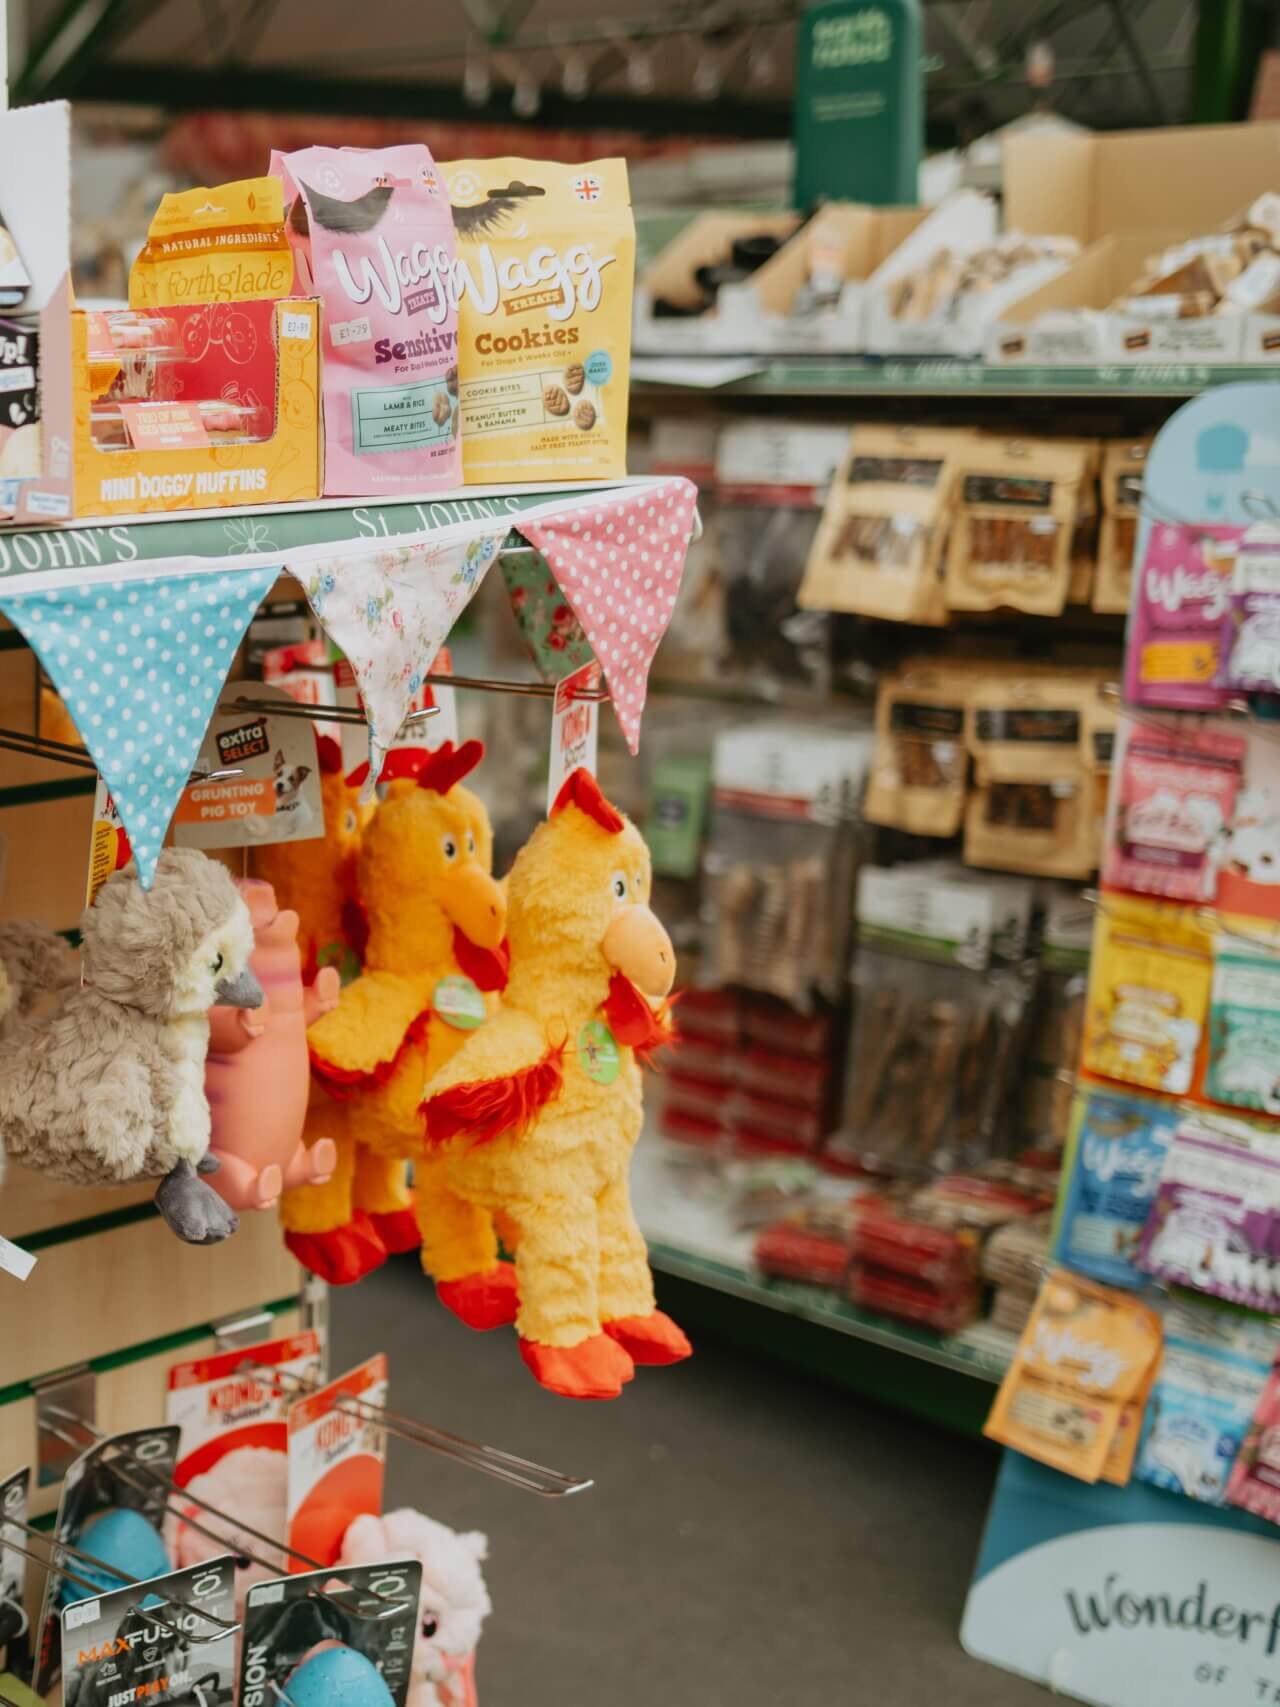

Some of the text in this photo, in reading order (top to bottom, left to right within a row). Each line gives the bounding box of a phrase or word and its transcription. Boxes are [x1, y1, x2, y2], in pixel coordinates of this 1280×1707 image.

[163, 231, 280, 254] NATURAL INGREDIENTS
[166, 262, 286, 301] Forthglade
[510, 291, 561, 310] TREATS
[475, 323, 579, 354] Cookies
[394, 364, 409, 373] For
[466, 383, 521, 398] COOKIE BITES
[383, 401, 405, 411] LAMB
[412, 399, 425, 408] RICE
[465, 408, 527, 424] PEANUT BUTTER
[484, 418, 517, 428] BANANA
[383, 421, 426, 434] MEATY BITES
[100, 476, 136, 502] MINI
[137, 472, 194, 499] DOGGY
[195, 468, 268, 494] MUFFINS
[414, 497, 521, 534] JOHN'S
[219, 726, 264, 748] extra
[222, 740, 266, 761] SELECT
[190, 782, 265, 802] GRUNTING
[201, 802, 257, 818] PIG TOY
